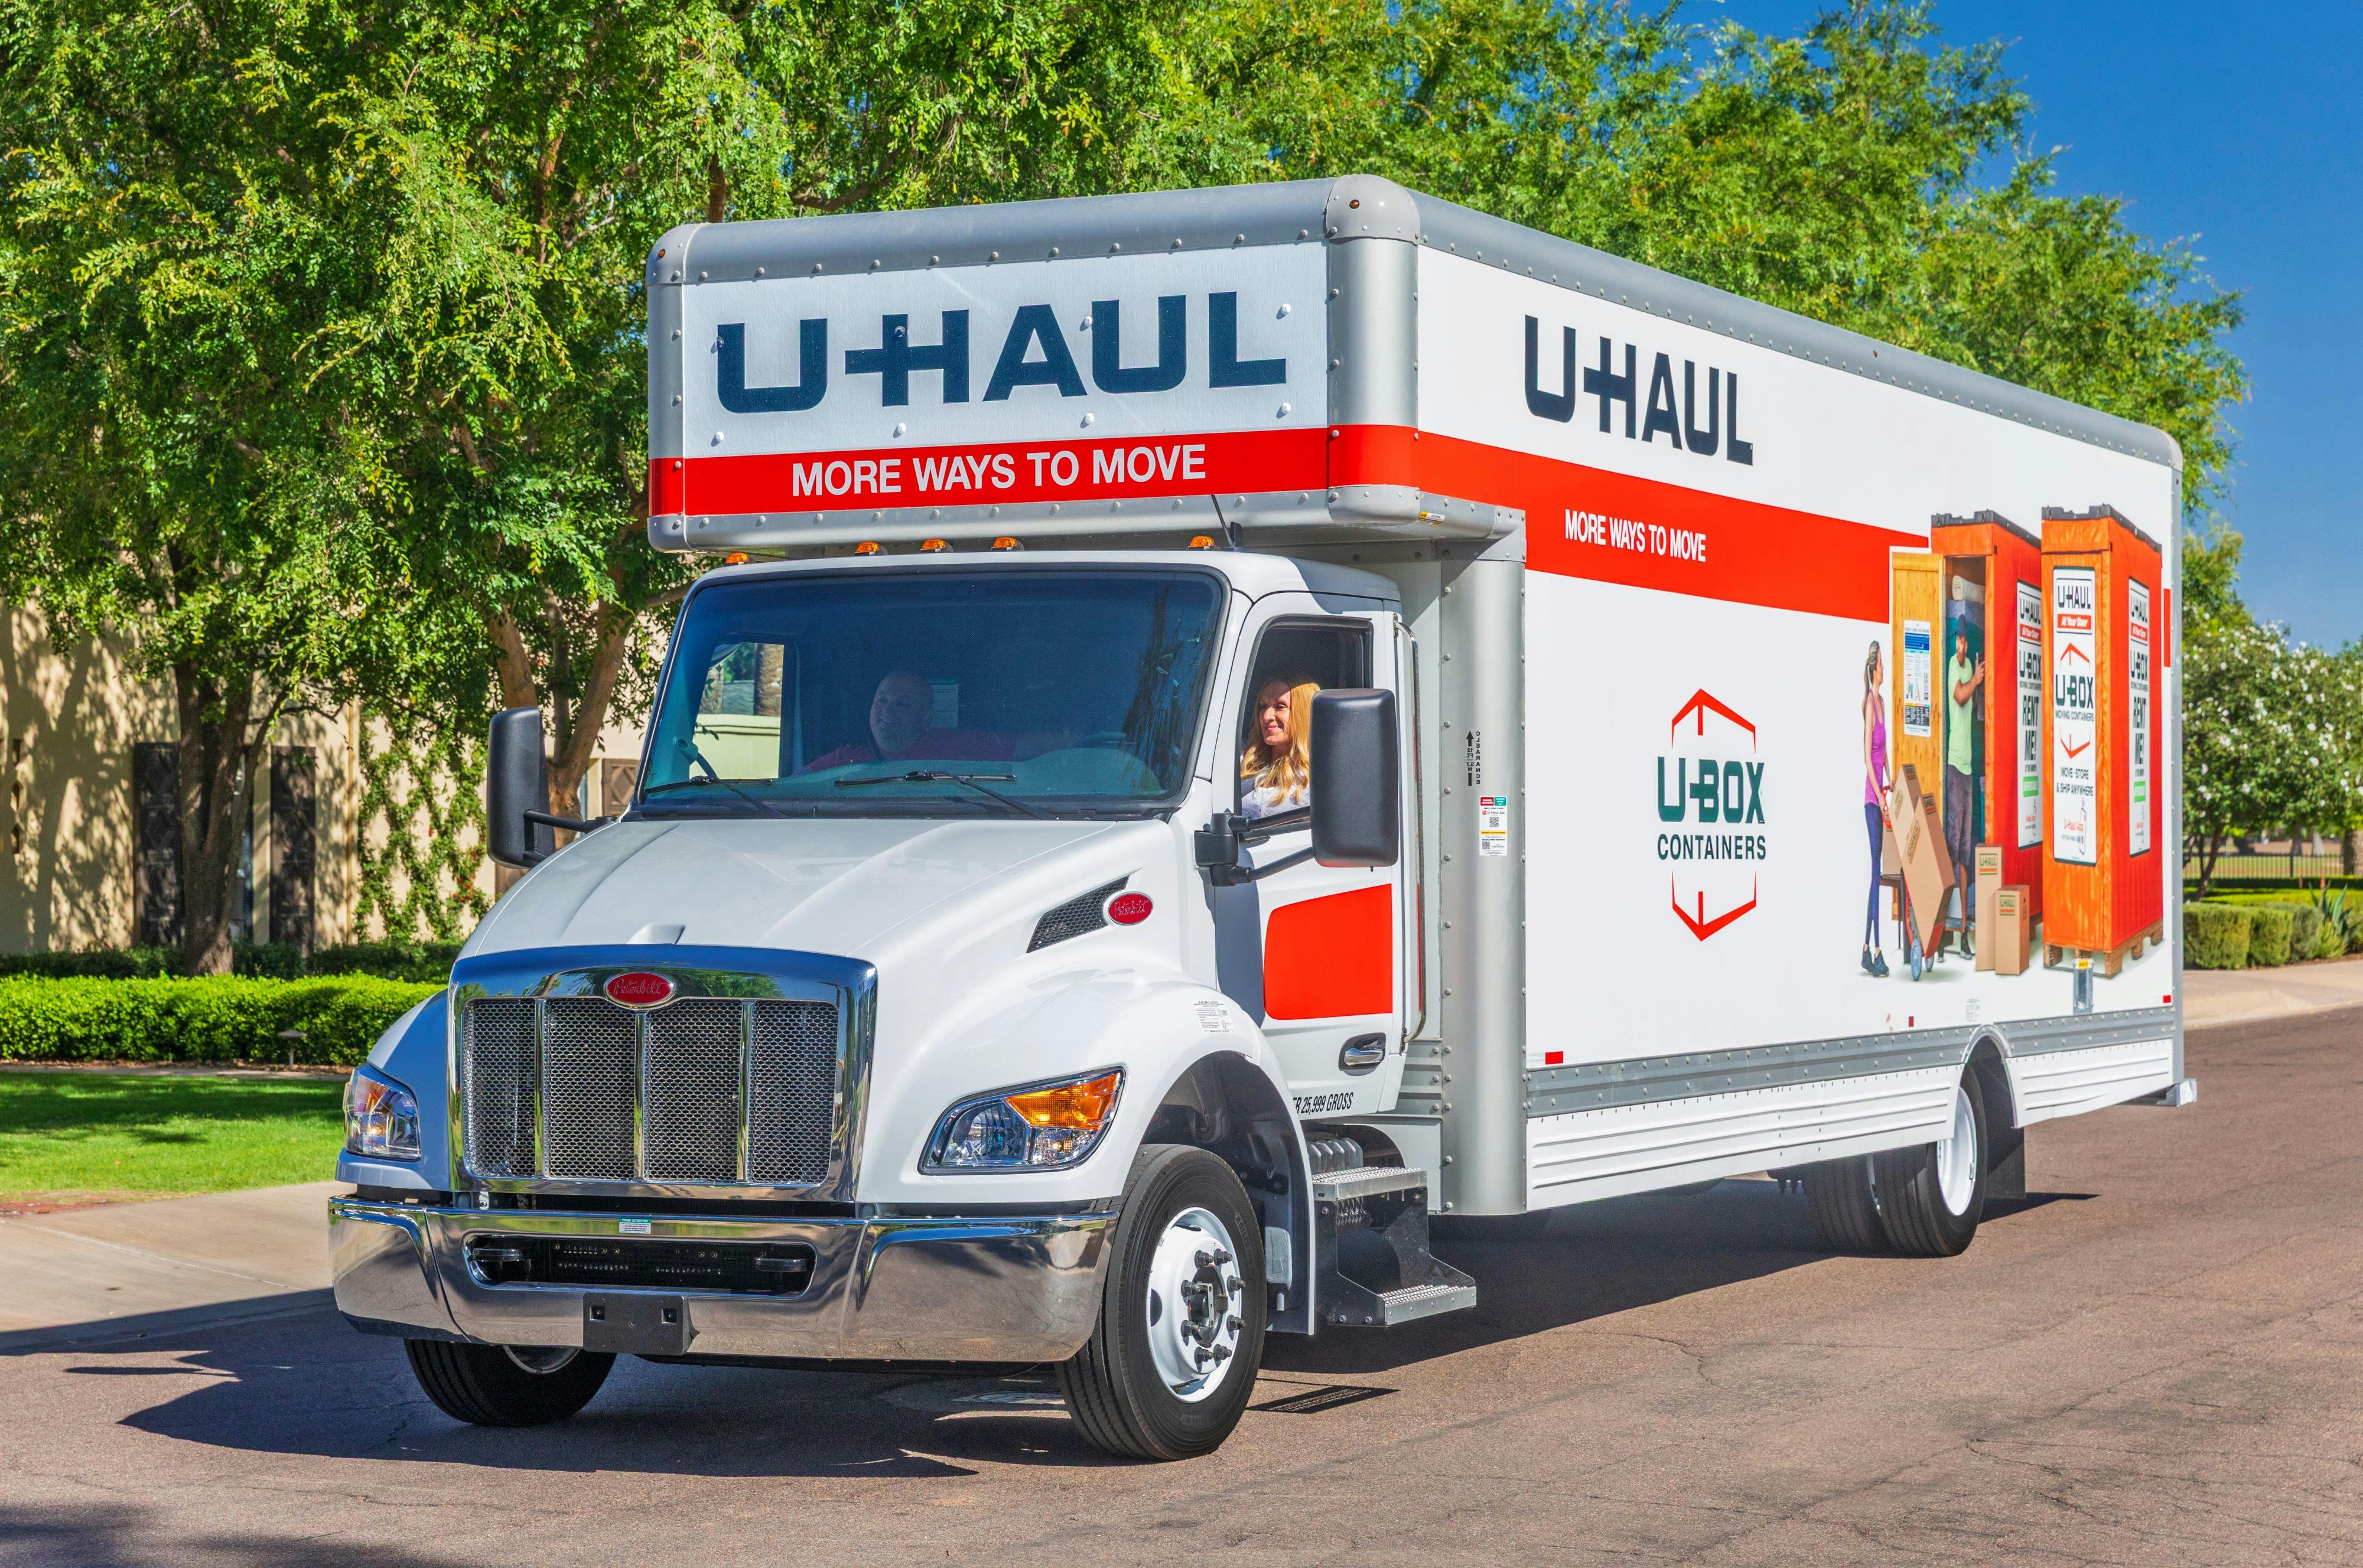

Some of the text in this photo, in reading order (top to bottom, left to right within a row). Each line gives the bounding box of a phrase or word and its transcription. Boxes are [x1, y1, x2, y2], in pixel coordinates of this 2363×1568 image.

[717, 291, 1287, 413] U-HAUL
[1525, 314, 1753, 466] U-HAUL
[792, 444, 1206, 497] MORE WAYS TO MOVE
[1565, 508, 1706, 562] MORE WAYS TO MOVE
[2058, 585, 2091, 609] U-HAUL
[2019, 650, 2041, 680] U-BOX
[2056, 674, 2094, 709] U-BOX
[2023, 695, 2039, 727] RENT
[2056, 709, 2094, 722] MOVING CONTAINERS
[2061, 767, 2089, 780] MOVE STORE
[1658, 757, 1765, 824] U-BOX
[2061, 783, 2070, 793] SHIP
[2071, 784, 2094, 796] ANYWHERE
[1658, 833, 1766, 860] CONTAINERS
[1115, 900, 1150, 918] Peterbilt
[614, 979, 663, 996] Peterbilt
[1300, 1095, 1326, 1115] 25,999
[1326, 1091, 1354, 1111] GROSS
